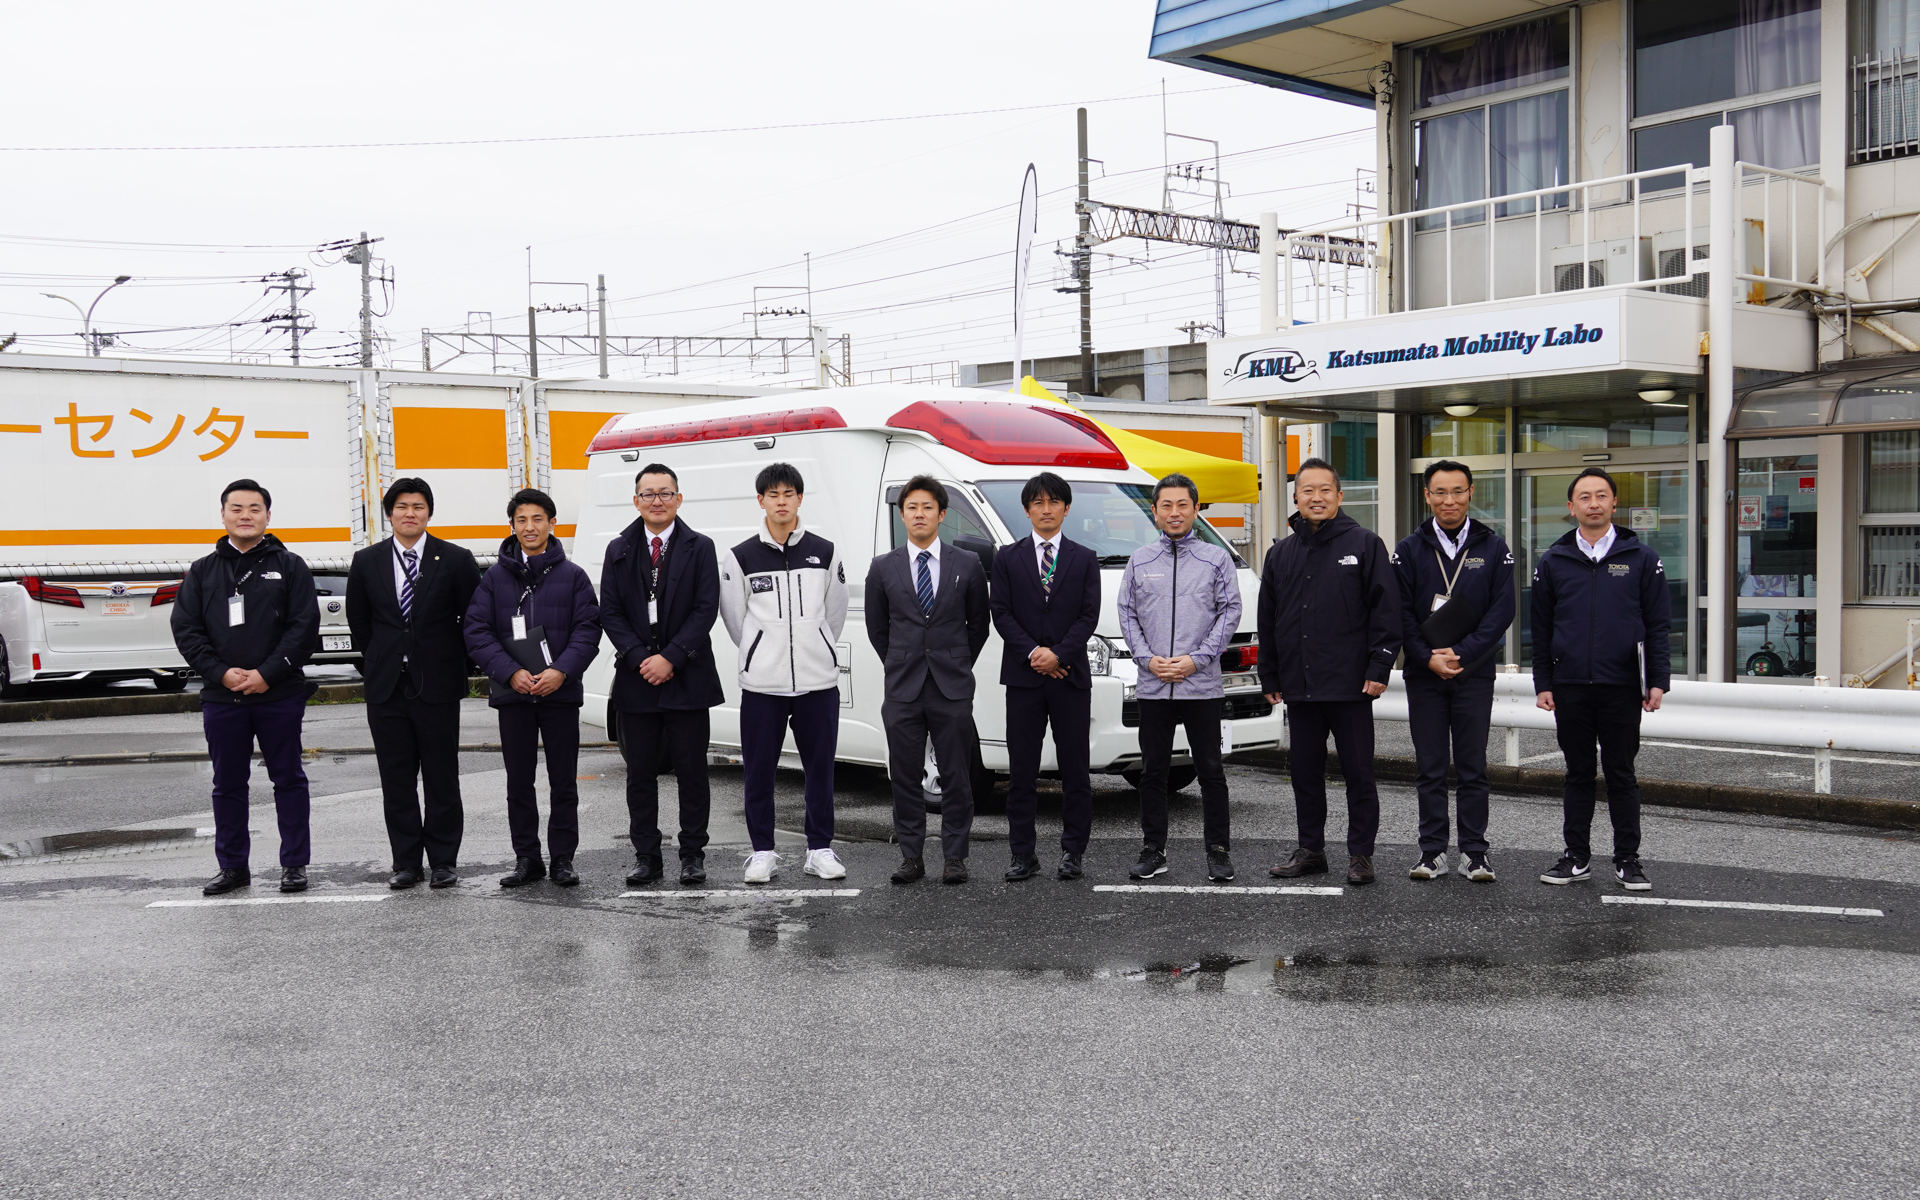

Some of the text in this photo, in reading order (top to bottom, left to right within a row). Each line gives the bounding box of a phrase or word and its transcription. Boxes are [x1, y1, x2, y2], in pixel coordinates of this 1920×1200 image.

[1325, 323, 1604, 370] Katsumata Mobility Labo
[1247, 356, 1297, 378] KML
